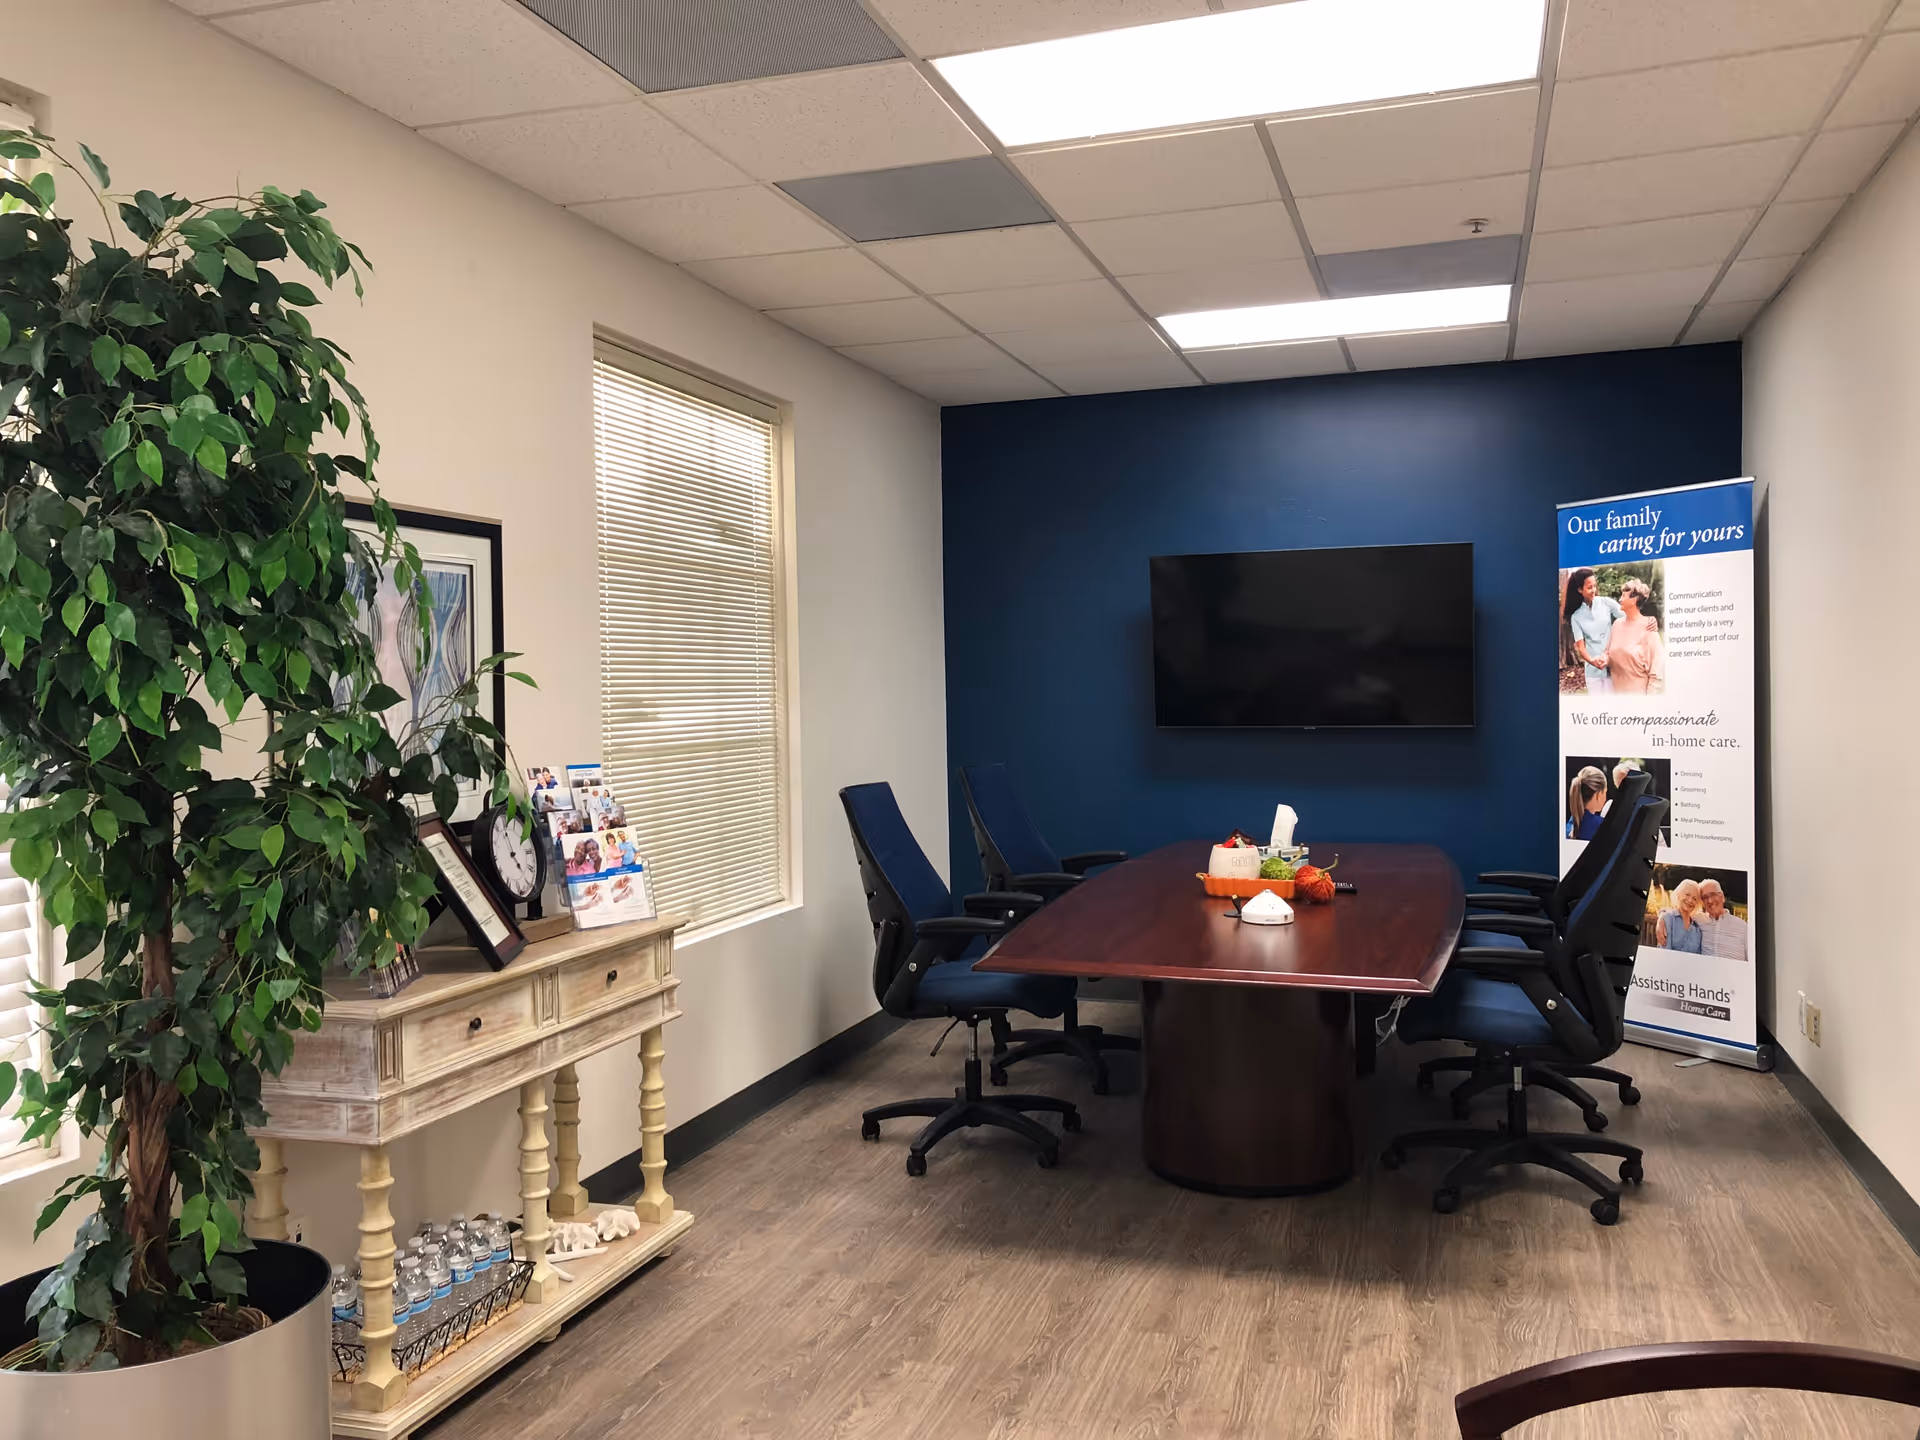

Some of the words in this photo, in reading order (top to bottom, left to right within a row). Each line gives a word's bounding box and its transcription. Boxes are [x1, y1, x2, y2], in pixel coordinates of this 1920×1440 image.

[1568, 516, 1601, 534] Our
[1606, 505, 1662, 530] family
[1599, 533, 1655, 555] caring
[1655, 527, 1685, 554] for
[1688, 525, 1744, 551] yours
[1669, 590, 1722, 600] Communication
[1669, 606, 1683, 614] with
[1697, 605, 1719, 613] clients
[1720, 603, 1734, 611] and
[1669, 621, 1683, 629] their
[1685, 619, 1705, 628] family
[1719, 619, 1734, 627] very
[1669, 635, 1702, 644] important
[1704, 634, 1718, 643] part
[1719, 633, 1726, 641] of
[1684, 649, 1712, 657] services.
[1571, 713, 1588, 725] We
[1591, 712, 1618, 726] offer
[1620, 709, 1719, 734] compassionate
[1652, 734, 1705, 748] in-home
[1709, 738, 1741, 748] care.
[1680, 786, 1707, 794] Grooming
[1630, 973, 1685, 998] Assisting
[1680, 1001, 1705, 1015] Home
[1706, 1006, 1727, 1019] Care
